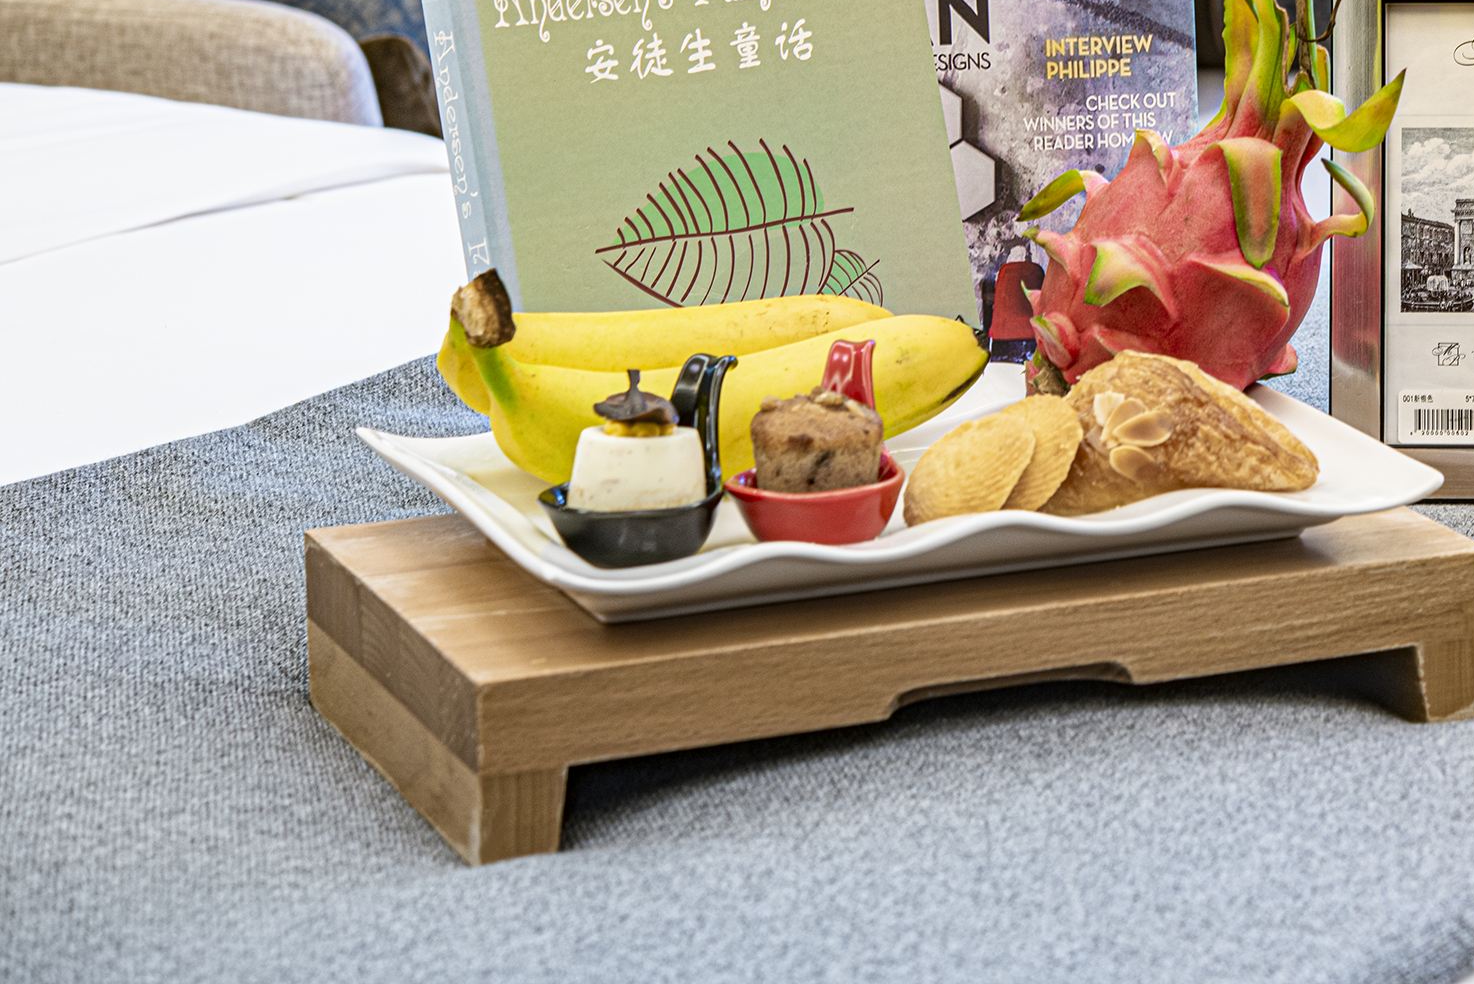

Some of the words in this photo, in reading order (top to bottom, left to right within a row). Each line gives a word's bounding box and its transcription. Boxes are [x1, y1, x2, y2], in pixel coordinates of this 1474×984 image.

[585, 18, 814, 84] 安徒生童话
[1045, 34, 1153, 57] INTERVIEW
[1046, 58, 1132, 80] PHILIPPE
[1086, 93, 1140, 111] CHECK
[1143, 92, 1177, 108] OUT
[433, 30, 479, 220] Andersen's
[1023, 115, 1095, 132] WINNERS
[1097, 114, 1119, 129] OF
[1122, 112, 1156, 128] THIS
[1034, 133, 1094, 152] READER
